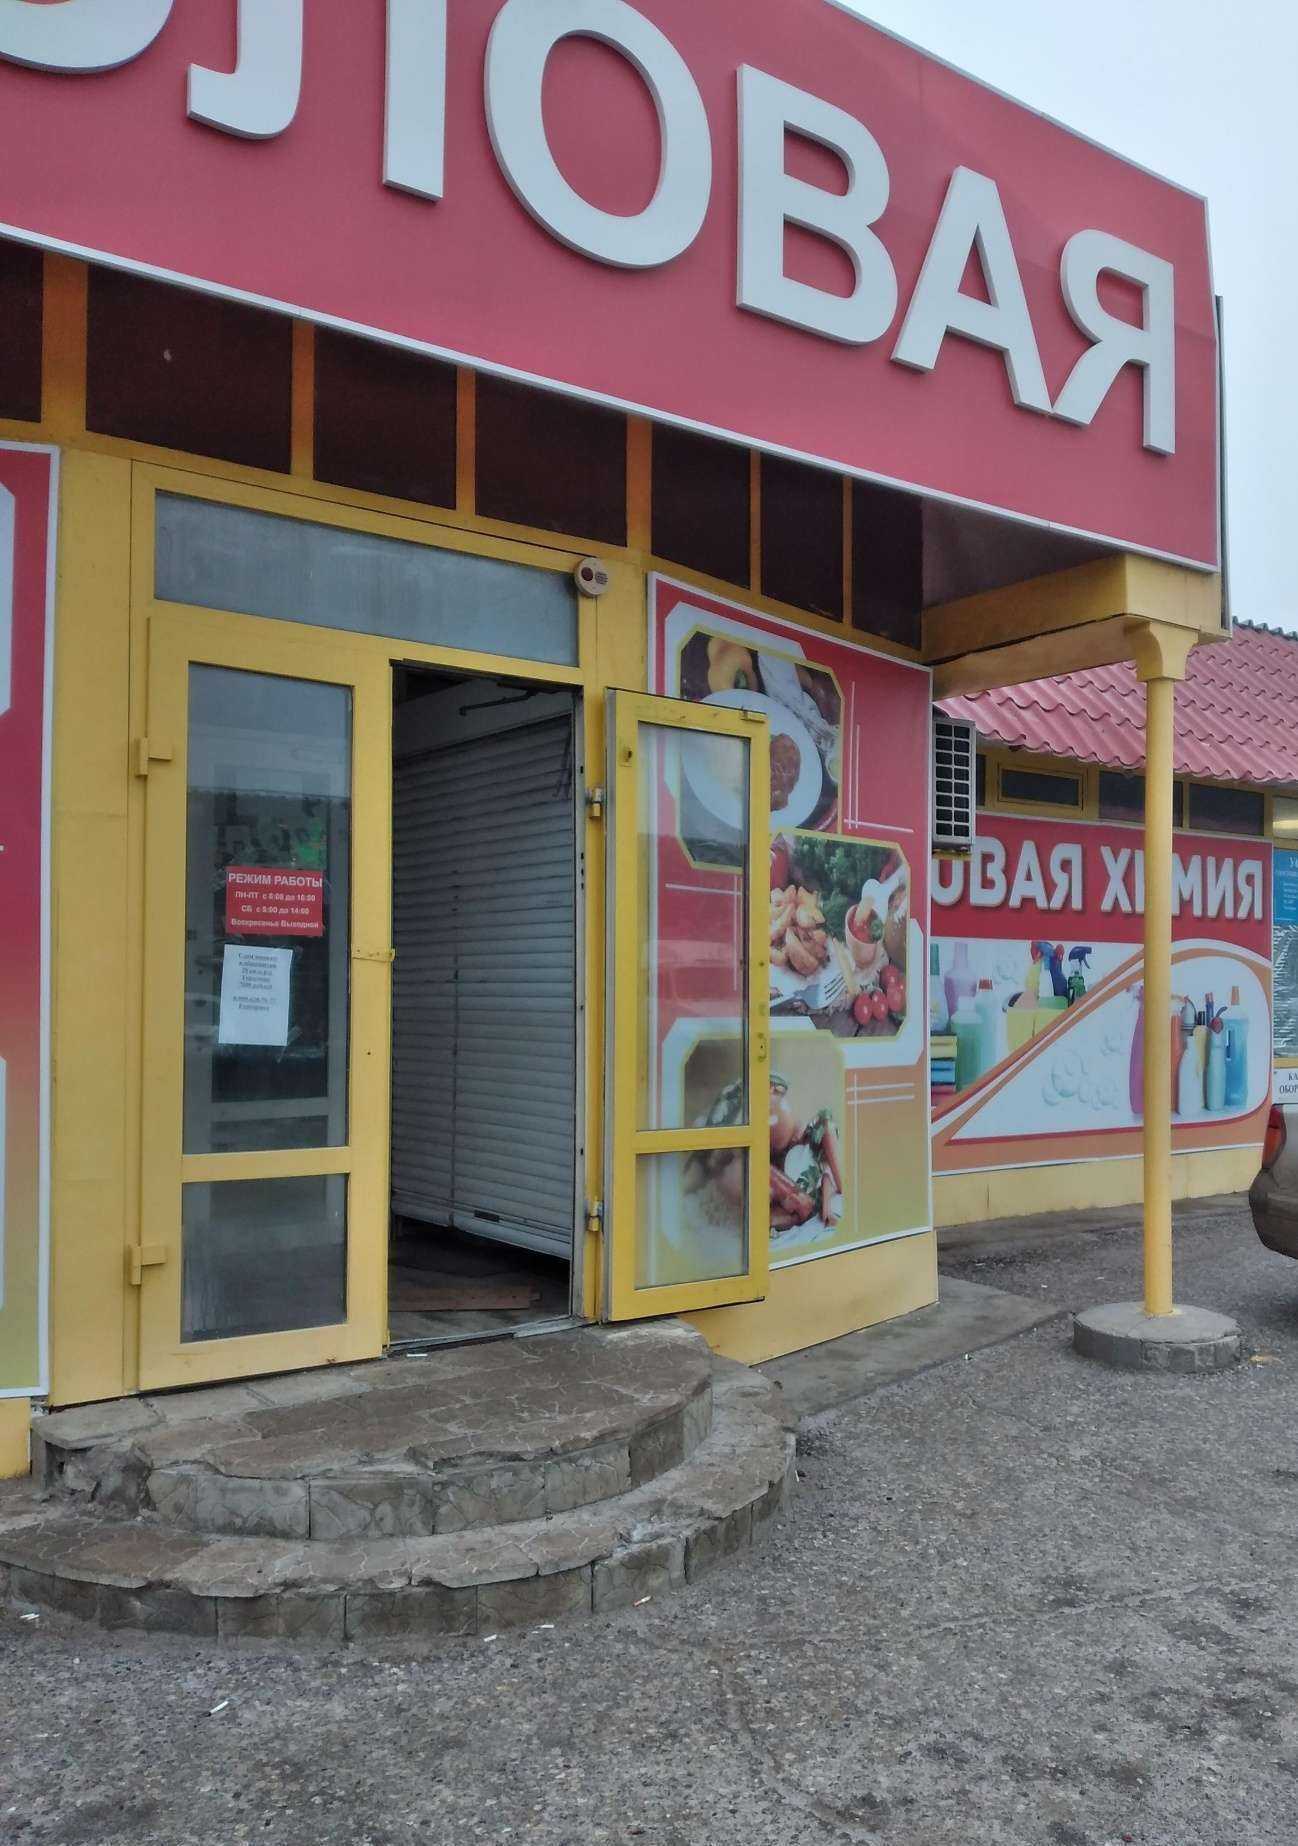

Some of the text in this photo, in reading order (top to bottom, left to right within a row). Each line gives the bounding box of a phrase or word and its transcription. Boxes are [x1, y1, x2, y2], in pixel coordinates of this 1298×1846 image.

[0, 0, 1176, 456] ЛОВАЯ
[228, 872, 322, 888] РЕЖИМ РАБОТЫ
[235, 891, 258, 899] ПН-ПТ
[241, 904, 252, 912] СБ
